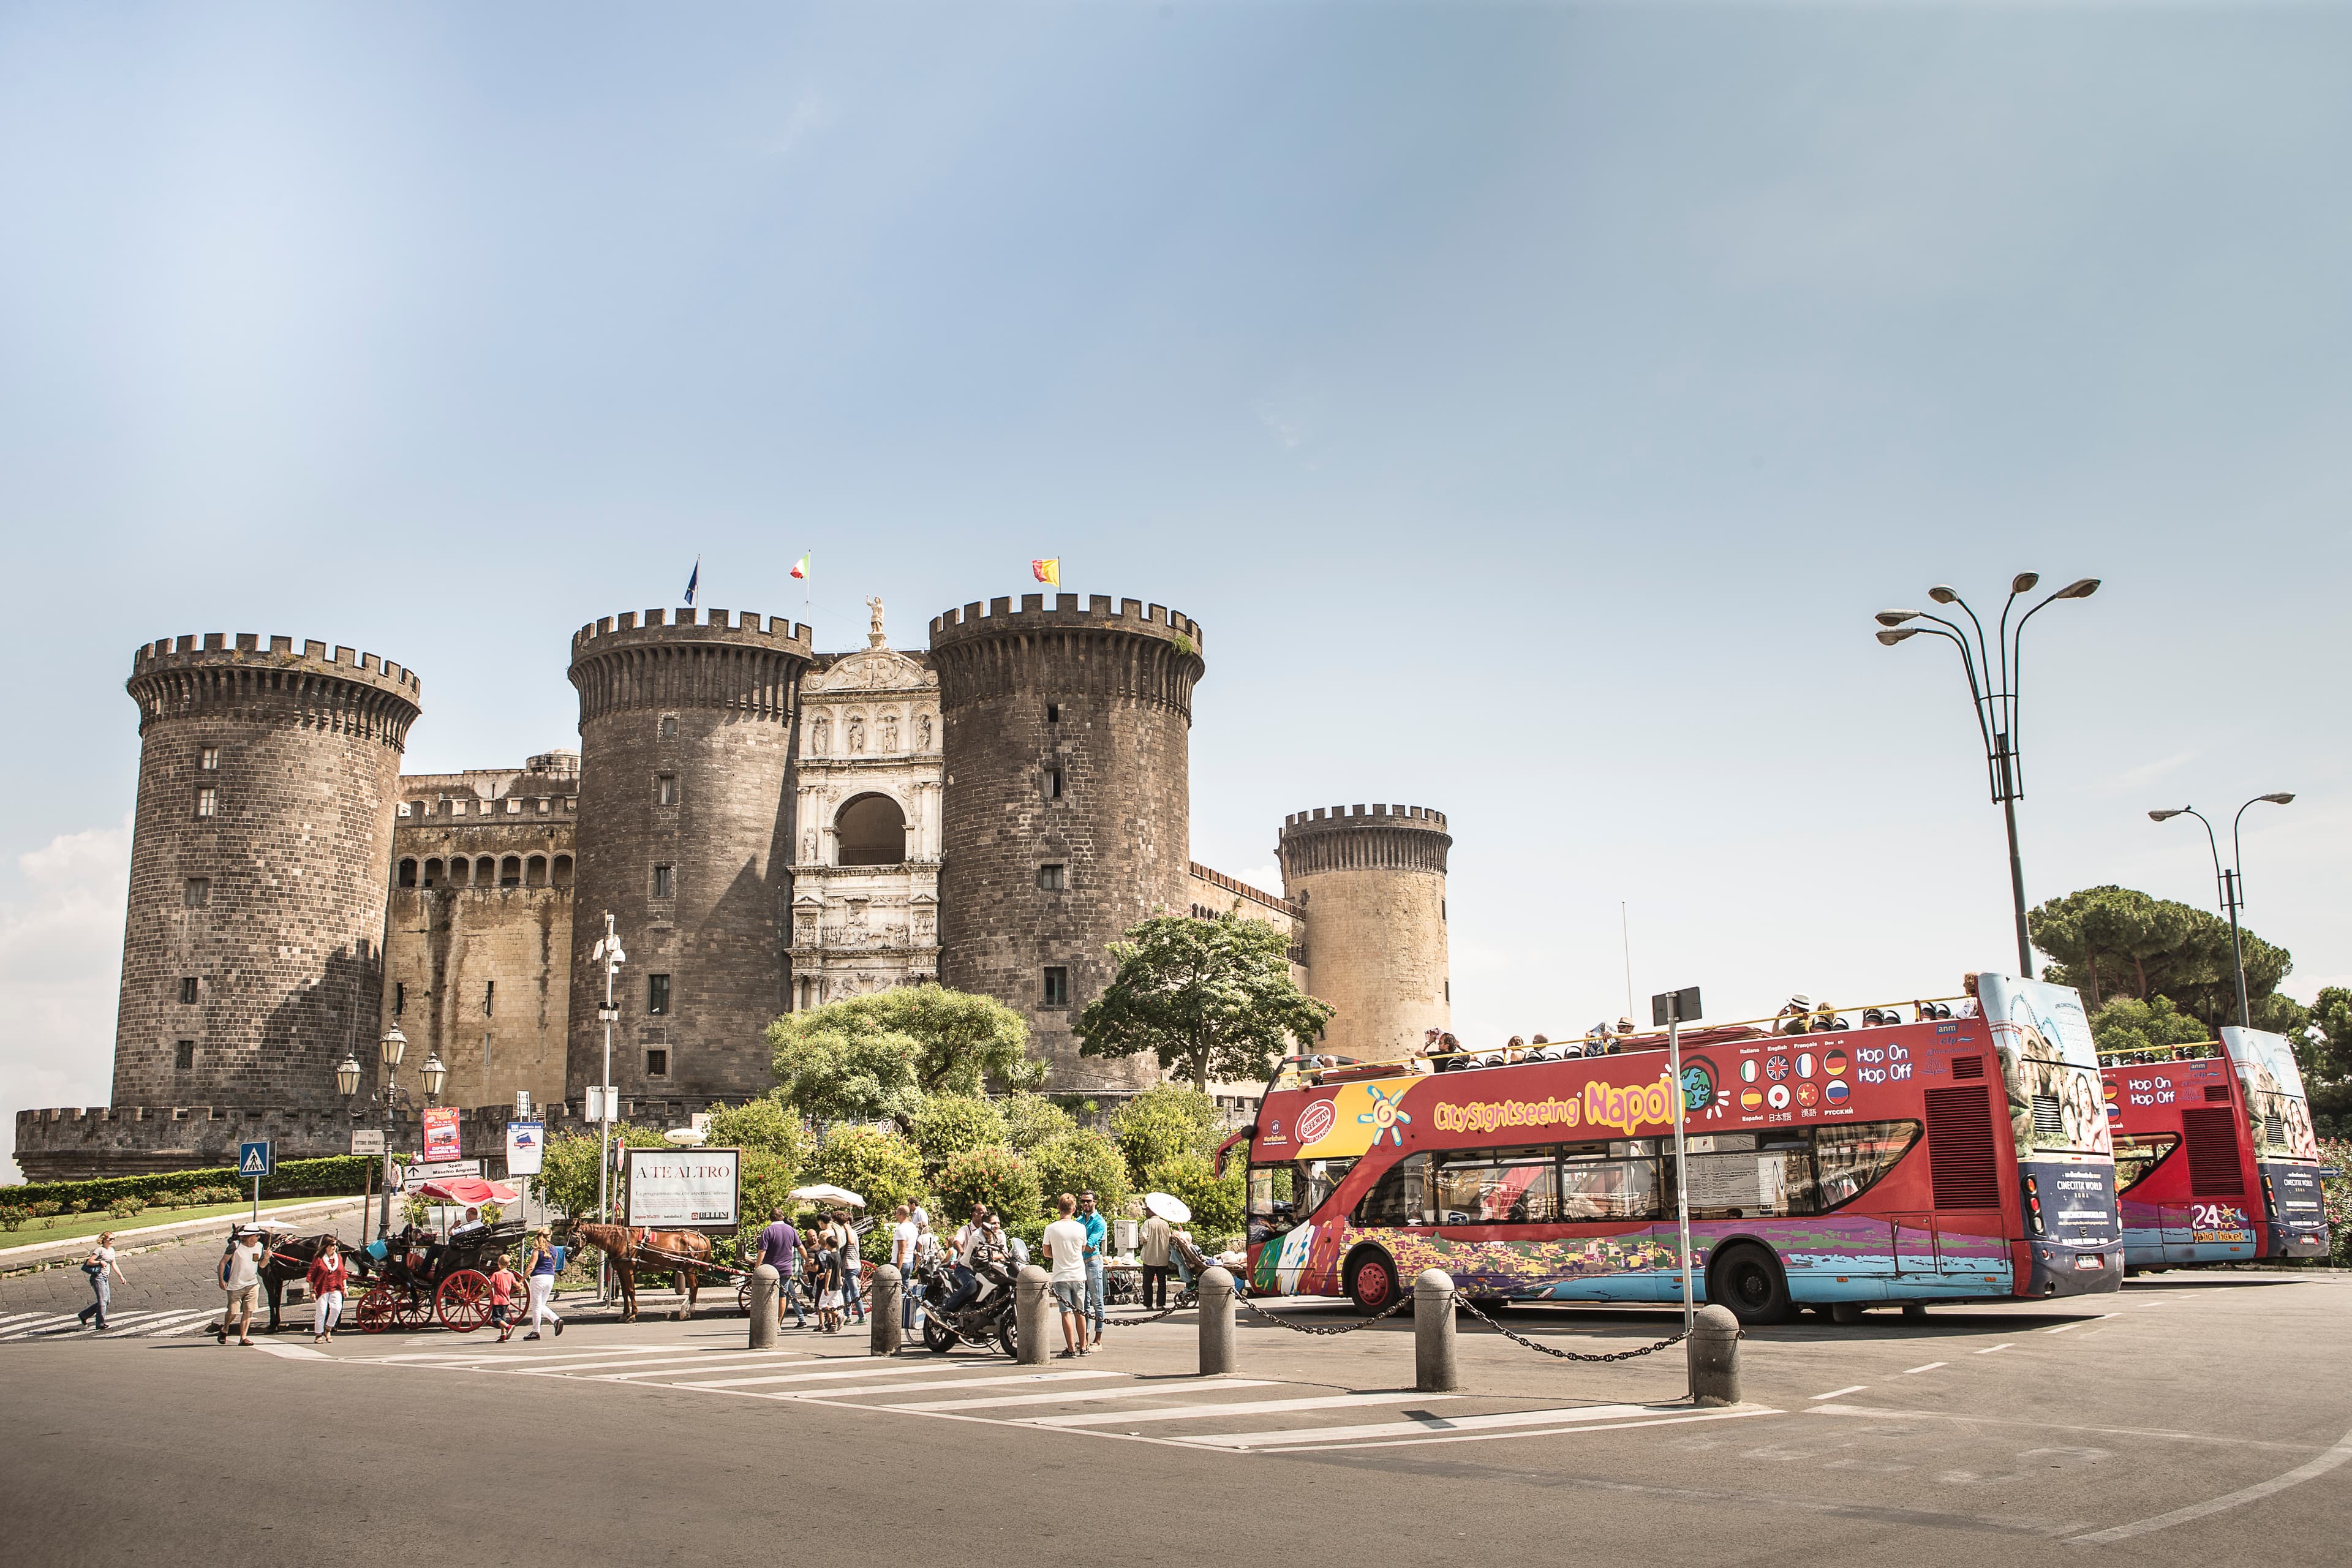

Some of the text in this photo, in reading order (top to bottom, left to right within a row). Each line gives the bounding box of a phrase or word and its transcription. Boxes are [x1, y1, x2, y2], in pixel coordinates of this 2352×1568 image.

[1856, 1044, 1909, 1063] Hop On
[1858, 1068, 1886, 1084] Hop
[1890, 1063, 1913, 1080] Off
[2128, 1079, 2152, 1091] Hop
[2154, 1076, 2171, 1088] On
[2130, 1090, 2176, 1106] Hop Off
[1305, 1104, 1318, 1115] YOUR
[1435, 1080, 1686, 1135] CitySightseeing Napol
[1801, 1109, 1817, 1117] 漢語
[1825, 1106, 1853, 1115] РУССКИЙ
[1302, 1110, 1329, 1133] OFFICIAL
[1769, 1112, 1792, 1122] 日本語
[1315, 1123, 1331, 1141] NAPOLI
[635, 1166, 730, 1178] A TE ALTRO
[2085, 1181, 2103, 1191] WORLD
[2191, 1204, 2222, 1229] 24
[2194, 1231, 2245, 1242] Valid Ticket
